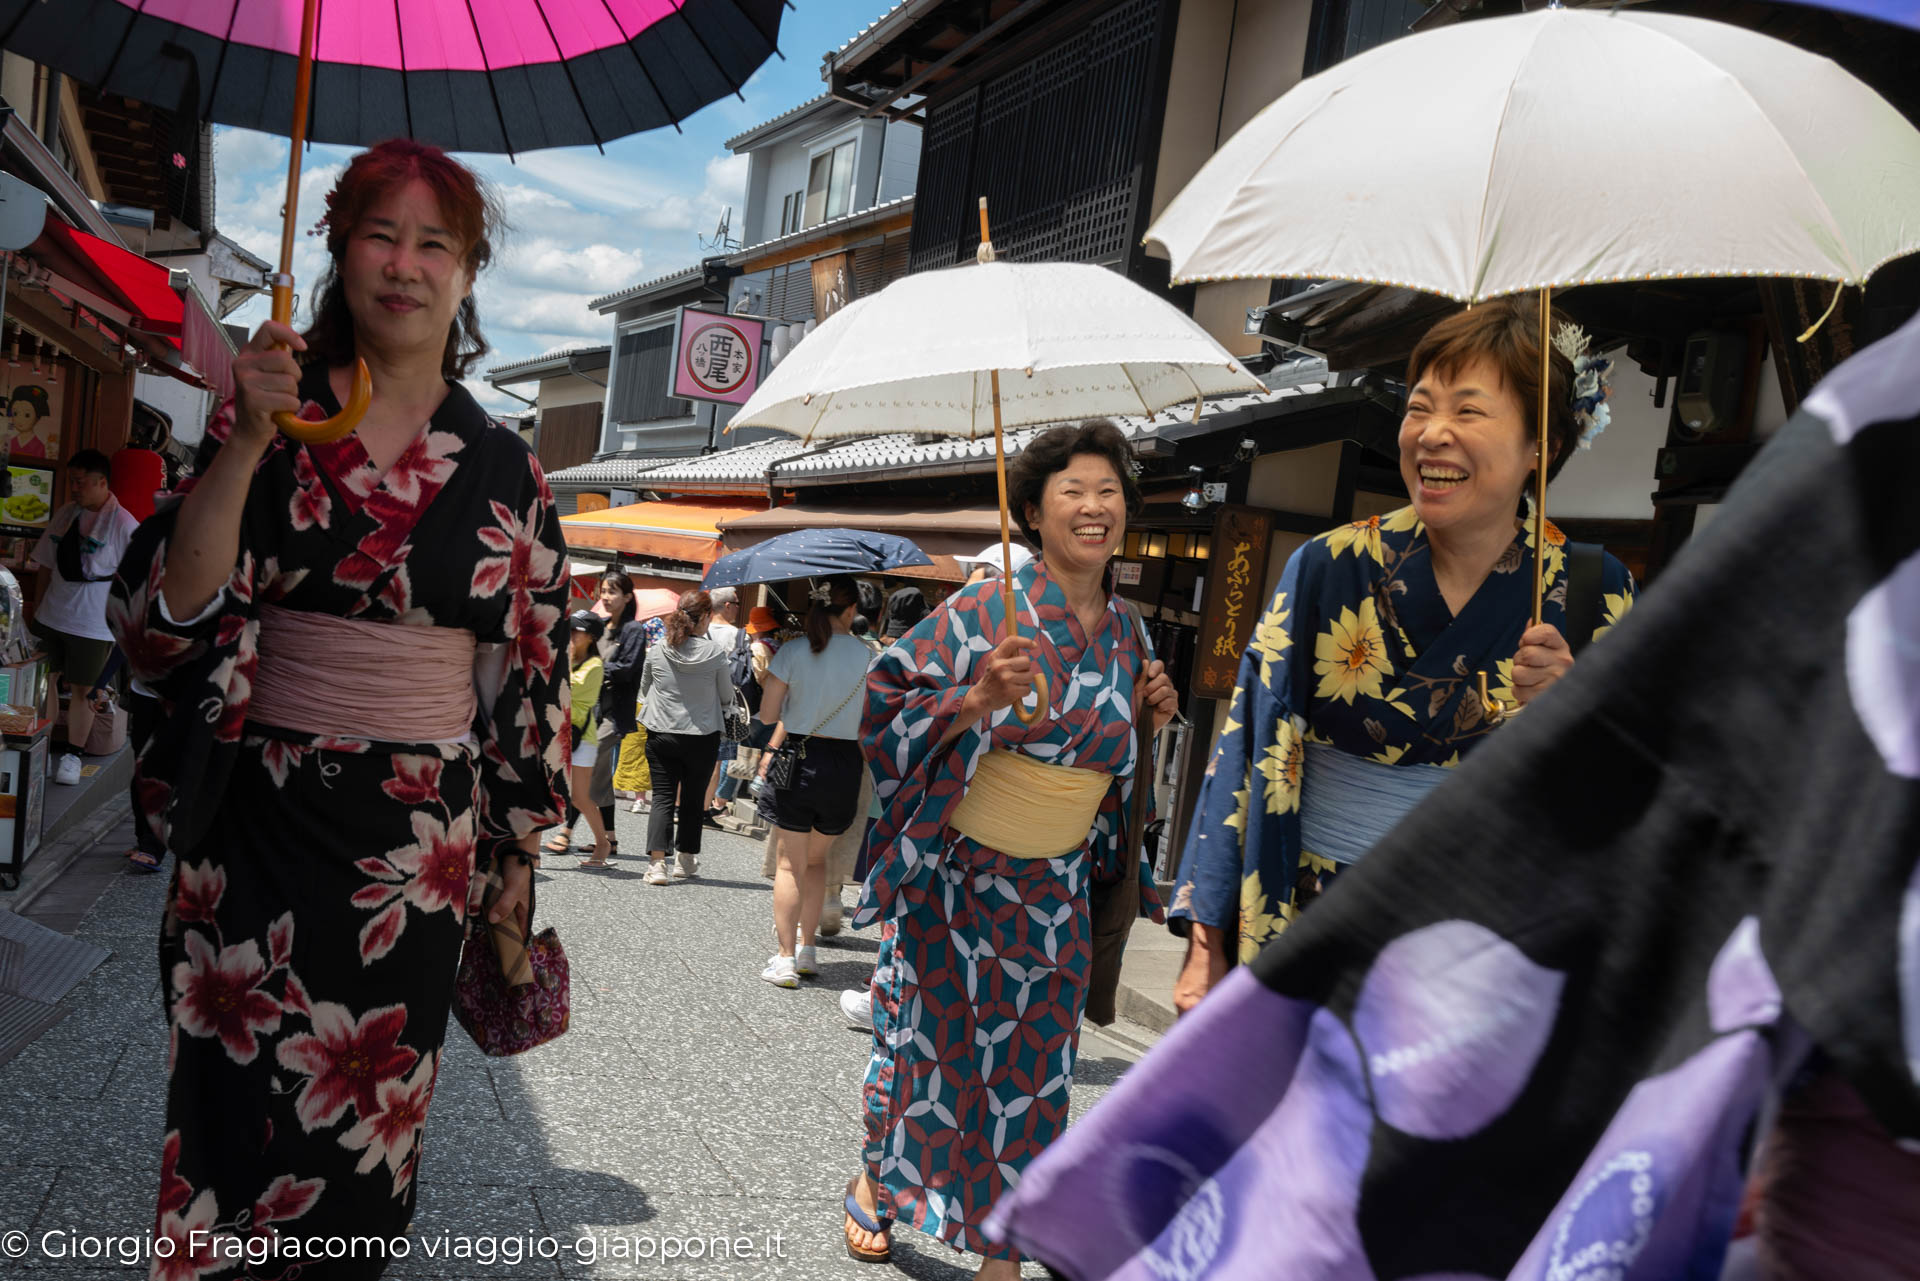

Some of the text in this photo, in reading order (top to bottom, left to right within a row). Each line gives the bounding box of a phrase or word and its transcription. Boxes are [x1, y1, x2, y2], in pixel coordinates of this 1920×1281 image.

[703, 334, 734, 384] 西尾
[731, 349, 745, 374] 本家
[1213, 541, 1251, 660] あぶらとり紙
